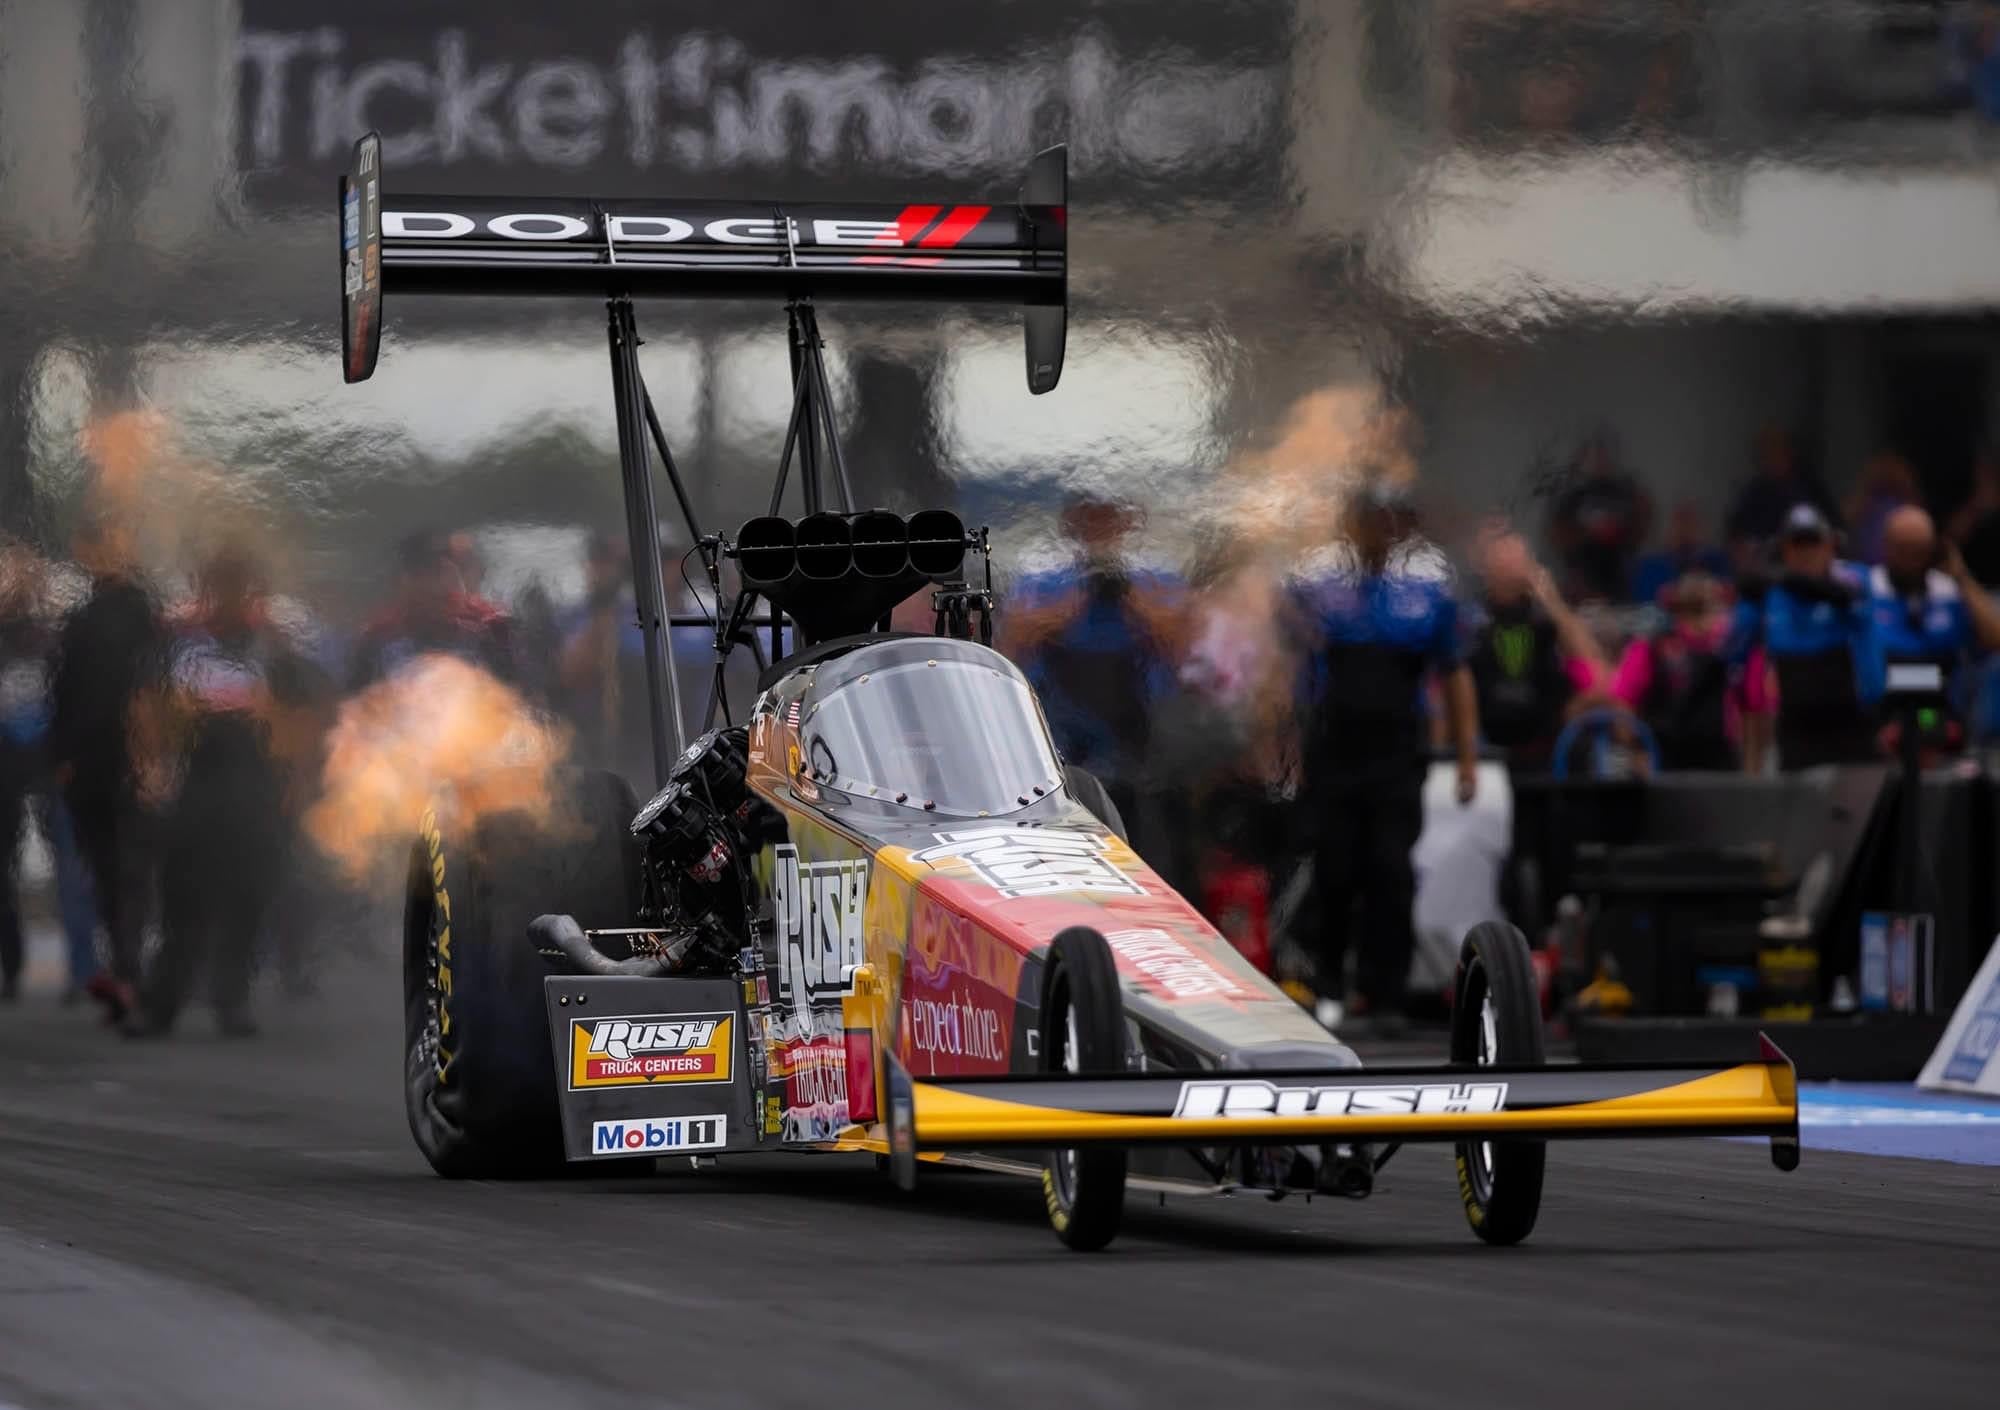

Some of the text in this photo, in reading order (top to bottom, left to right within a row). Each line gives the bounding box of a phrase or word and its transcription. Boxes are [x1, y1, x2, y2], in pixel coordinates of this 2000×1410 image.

[381, 212, 904, 246] DODGE
[908, 829, 1152, 898] RUSH
[775, 843, 868, 1045] RUSH
[589, 1020, 717, 1060] RUSH
[913, 990, 962, 1076] expect
[600, 1058, 702, 1075] TRUCK CENTERS
[792, 1049, 825, 1103] TRUCK
[1172, 1081, 1509, 1119] RUSH
[598, 1121, 681, 1150] Mobil
